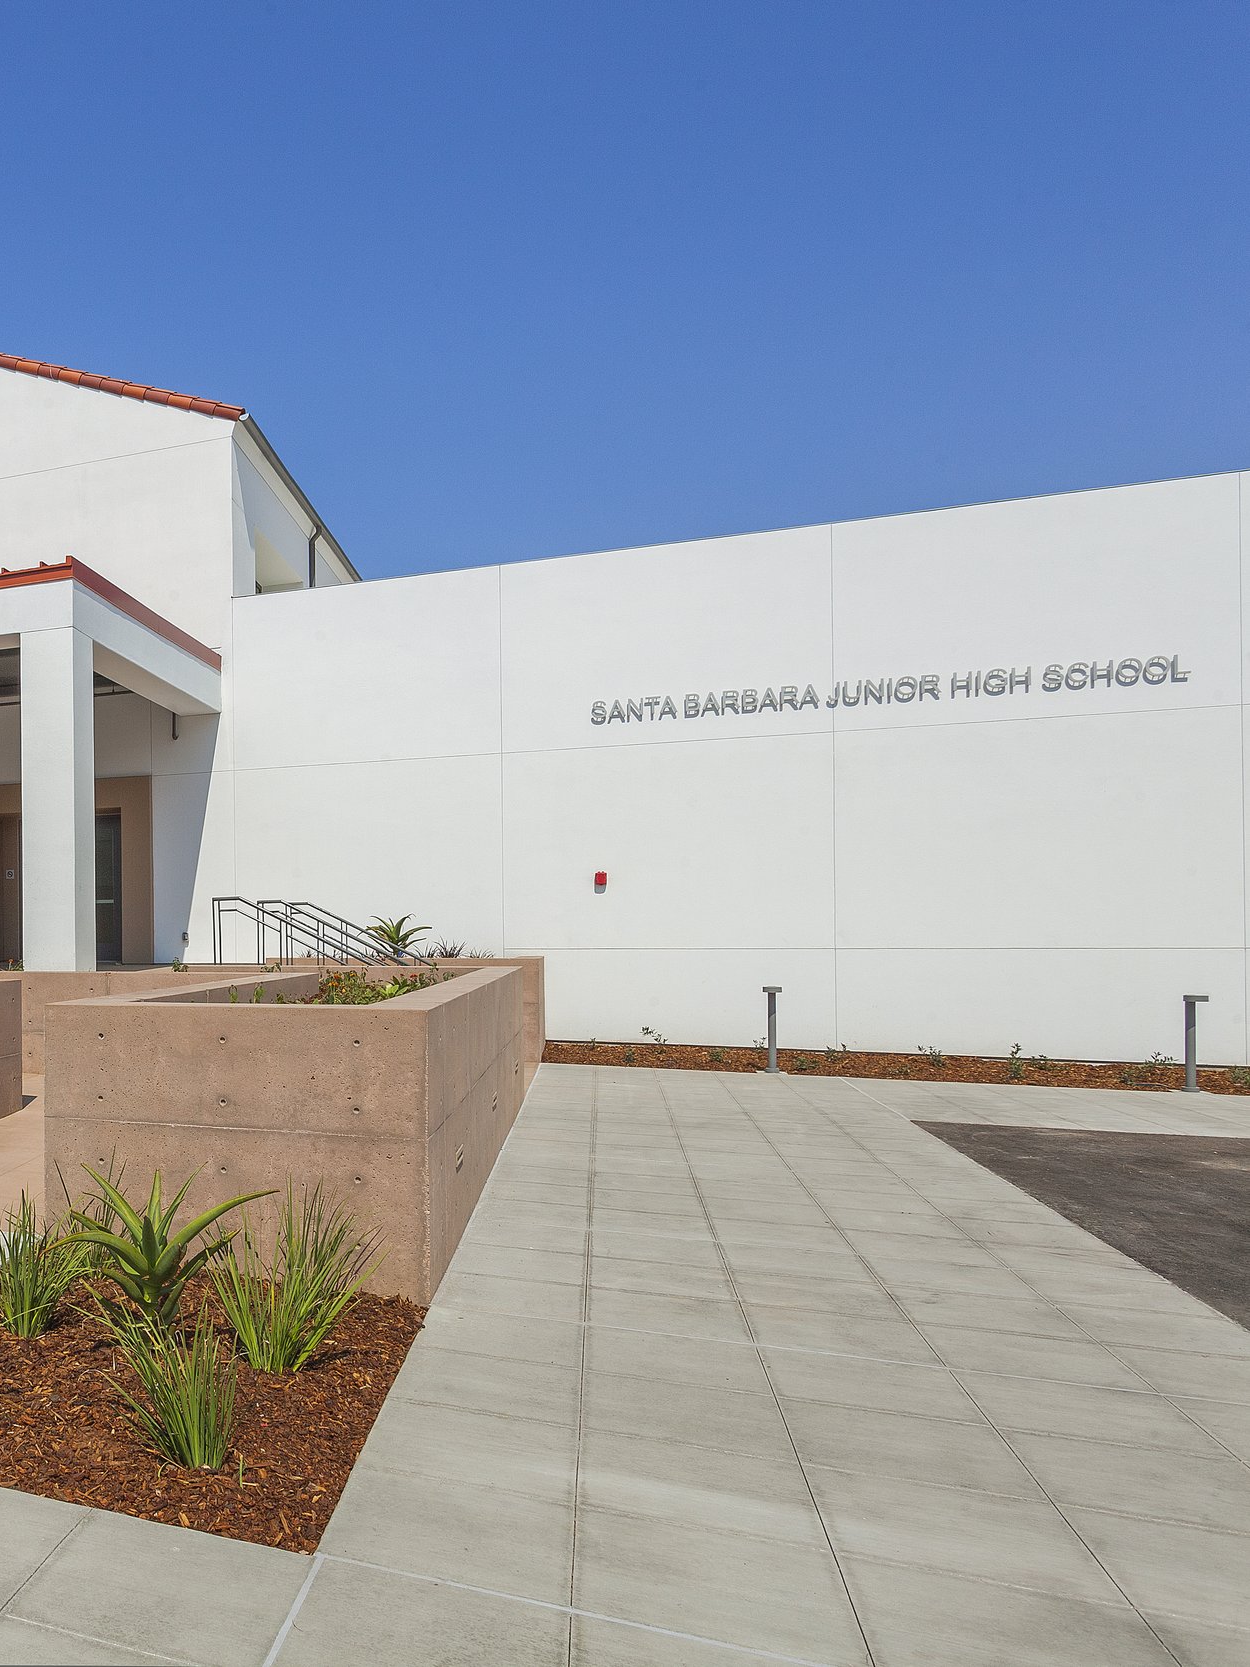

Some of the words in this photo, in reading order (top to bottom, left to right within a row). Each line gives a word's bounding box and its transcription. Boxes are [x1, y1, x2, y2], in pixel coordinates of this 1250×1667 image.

[590, 695, 678, 724] SANTA
[684, 684, 819, 717] BARBARA
[826, 674, 942, 708] JUNIOR
[951, 666, 1032, 698] HIGH
[1041, 654, 1192, 691] SCHOOL
